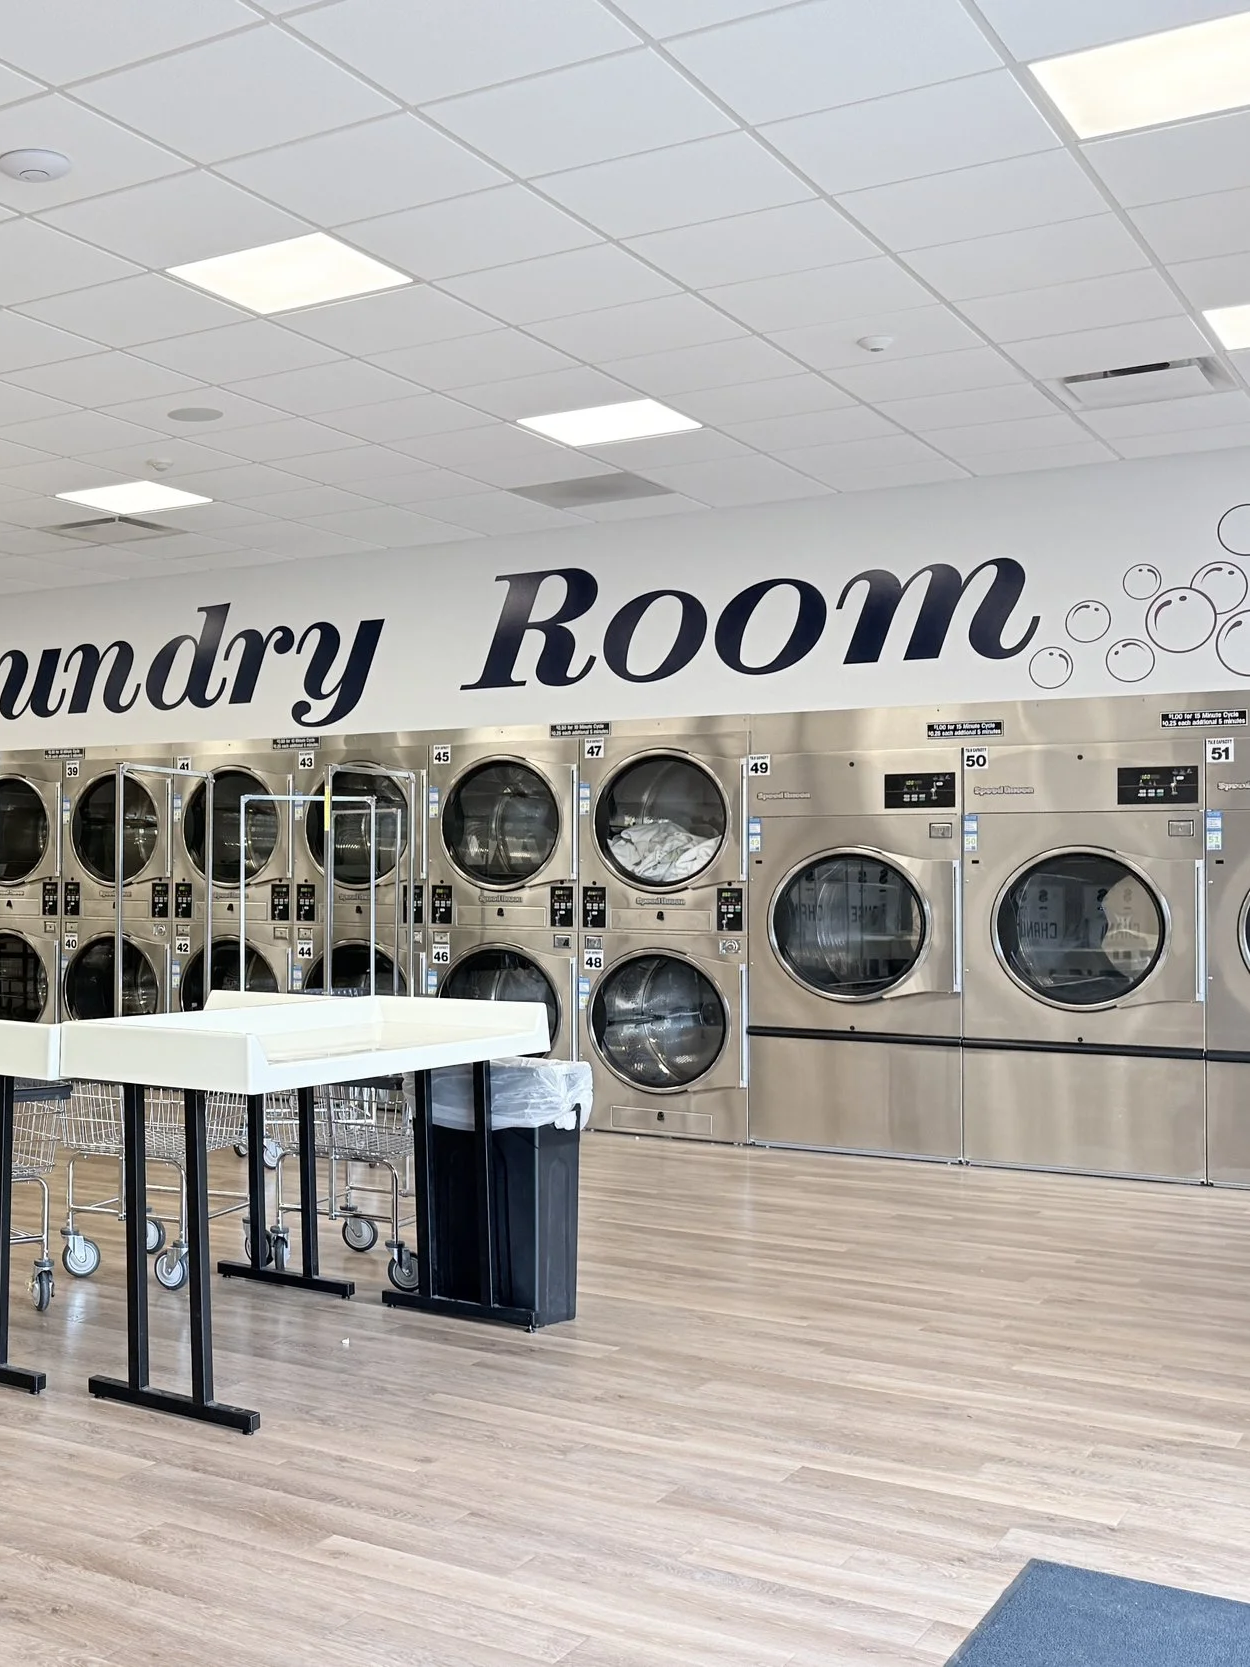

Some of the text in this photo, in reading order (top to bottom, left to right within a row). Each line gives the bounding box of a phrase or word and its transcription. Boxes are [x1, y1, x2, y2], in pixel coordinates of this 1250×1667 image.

[460, 557, 1040, 690] Room
[1223, 711, 1239, 719] Cycle
[981, 722, 996, 730] Cycle
[587, 746, 602, 756] 47
[1211, 747, 1230, 760] 51
[435, 751, 449, 762] 45
[965, 755, 987, 767] 50
[179, 762, 190, 770] 41
[300, 757, 313, 767] 43
[67, 766, 78, 776] 39
[750, 762, 768, 773] 49
[757, 791, 811, 800] Speed Queen
[974, 785, 1034, 796] Speed Queen
[65, 939, 77, 948] 40
[177, 943, 189, 953] 42
[299, 947, 312, 957] 44
[434, 952, 448, 962] 46
[586, 957, 602, 968] 48
